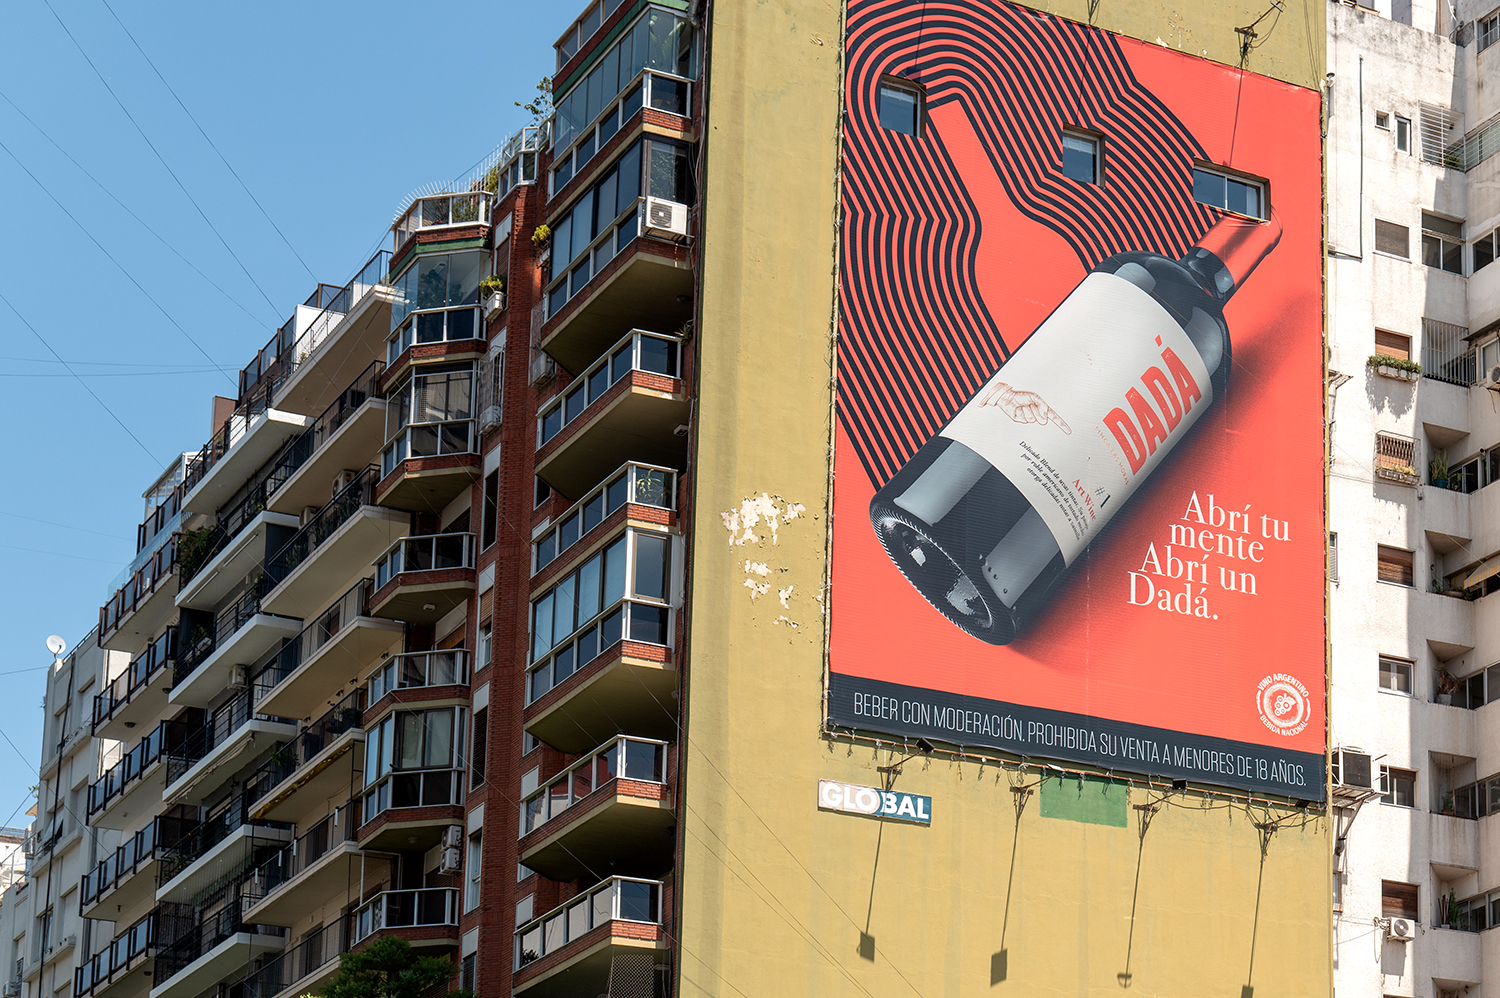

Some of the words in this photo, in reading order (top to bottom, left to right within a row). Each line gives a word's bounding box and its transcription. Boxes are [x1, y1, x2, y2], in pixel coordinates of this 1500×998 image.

[1102, 334, 1202, 476] DADÁ
[1072, 479, 1086, 497] Art
[1181, 490, 1252, 535] Abrí
[1260, 514, 1292, 542] tu
[1168, 523, 1265, 563] mente
[1138, 541, 1210, 585] Abrí
[1218, 566, 1258, 596] un
[1127, 570, 1219, 620] Dadá.
[1257, 675, 1273, 691] VINO
[1273, 673, 1309, 698] ARGENTINO
[854, 692, 899, 721] BEBER
[901, 700, 930, 726] CON
[933, 705, 1025, 743] MODERACIÓN.
[1028, 721, 1097, 753] PROHIBIDA
[1100, 732, 1117, 757] SU
[1120, 736, 1160, 764] VENTA
[1162, 744, 1171, 765] A
[1174, 745, 1235, 775] MENORES
[1237, 755, 1252, 779] DE
[1255, 758, 1267, 781] 18
[1270, 758, 1307, 787] AÑOS.
[1260, 714, 1280, 735] BEBIDA
[821, 782, 930, 820] GLOBAL
